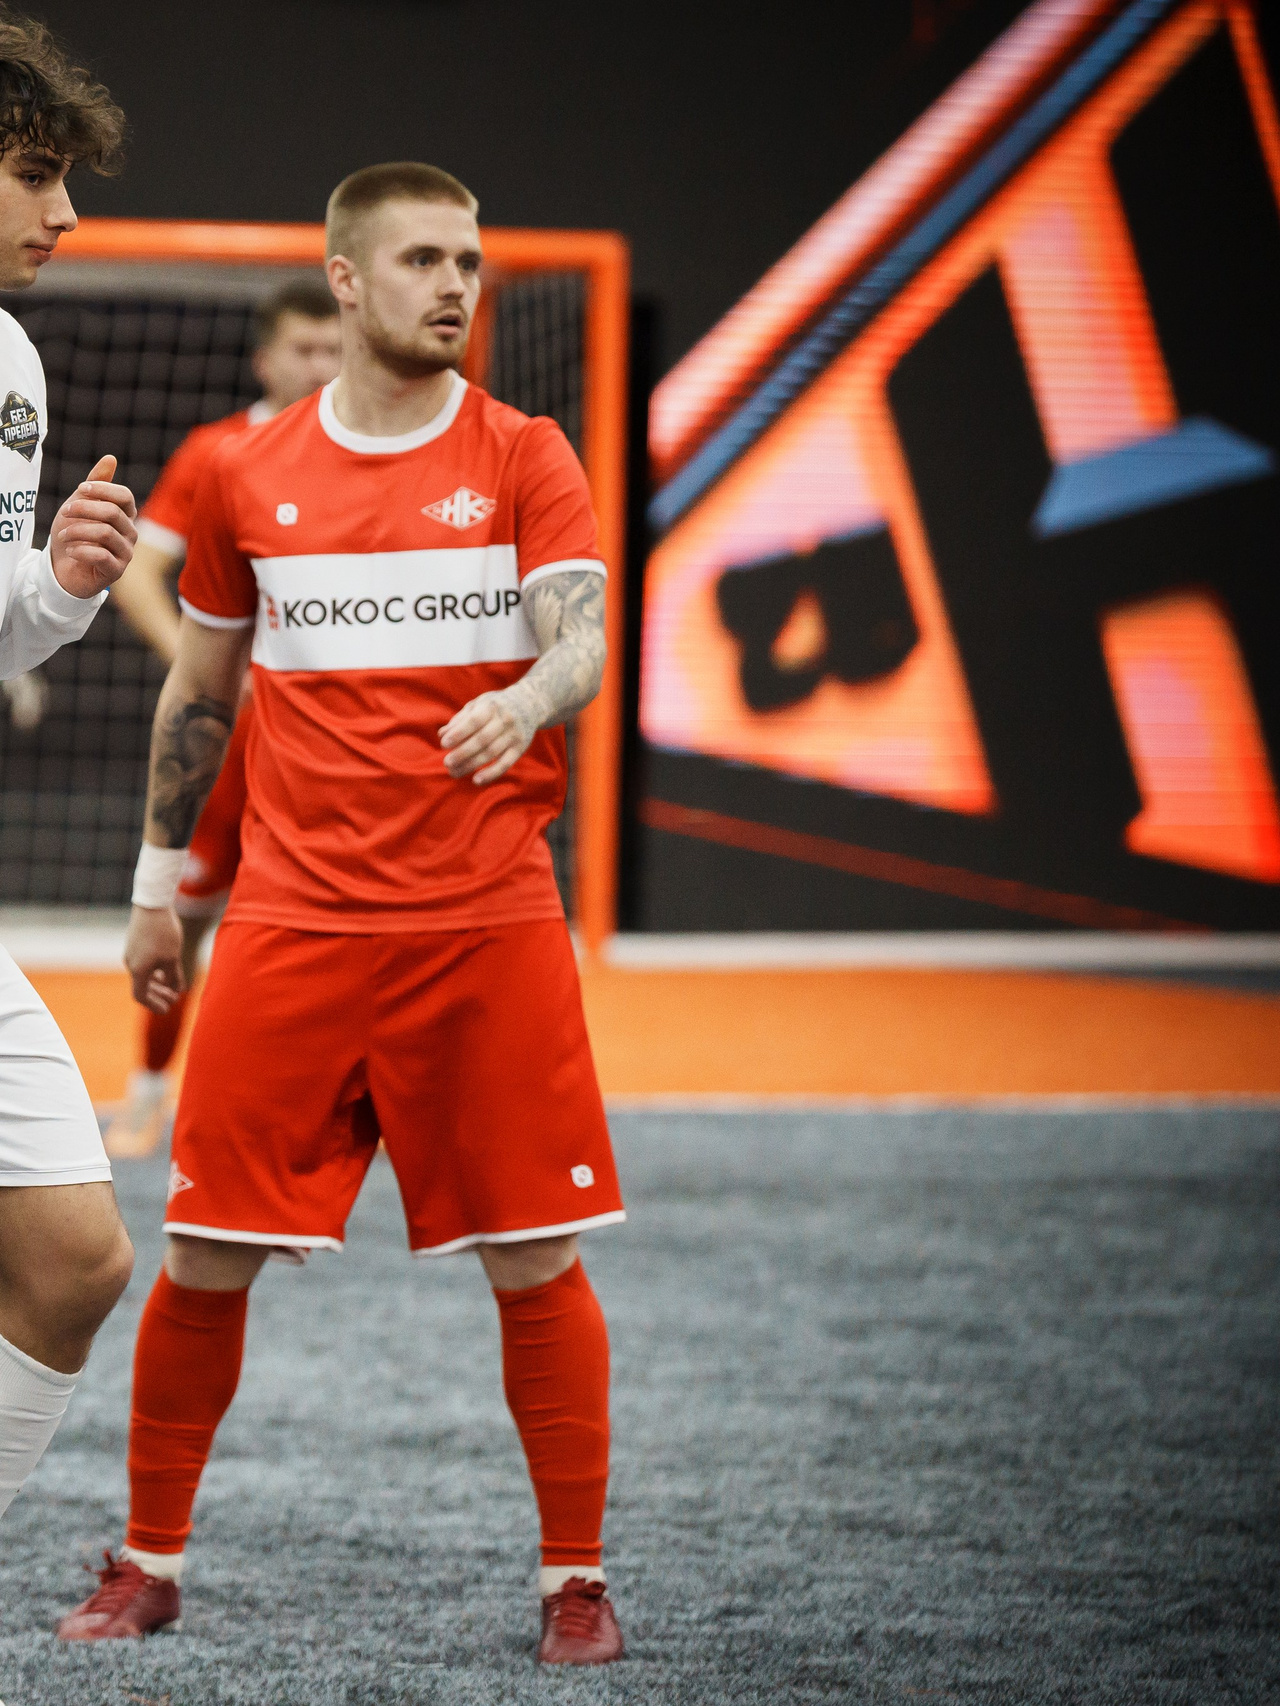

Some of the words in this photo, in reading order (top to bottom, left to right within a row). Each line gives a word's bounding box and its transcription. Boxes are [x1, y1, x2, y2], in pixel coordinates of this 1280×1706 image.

[10, 407, 27, 425] БЕЗ
[284, 597, 404, 628] KOKOC
[414, 590, 521, 620] GROUP
